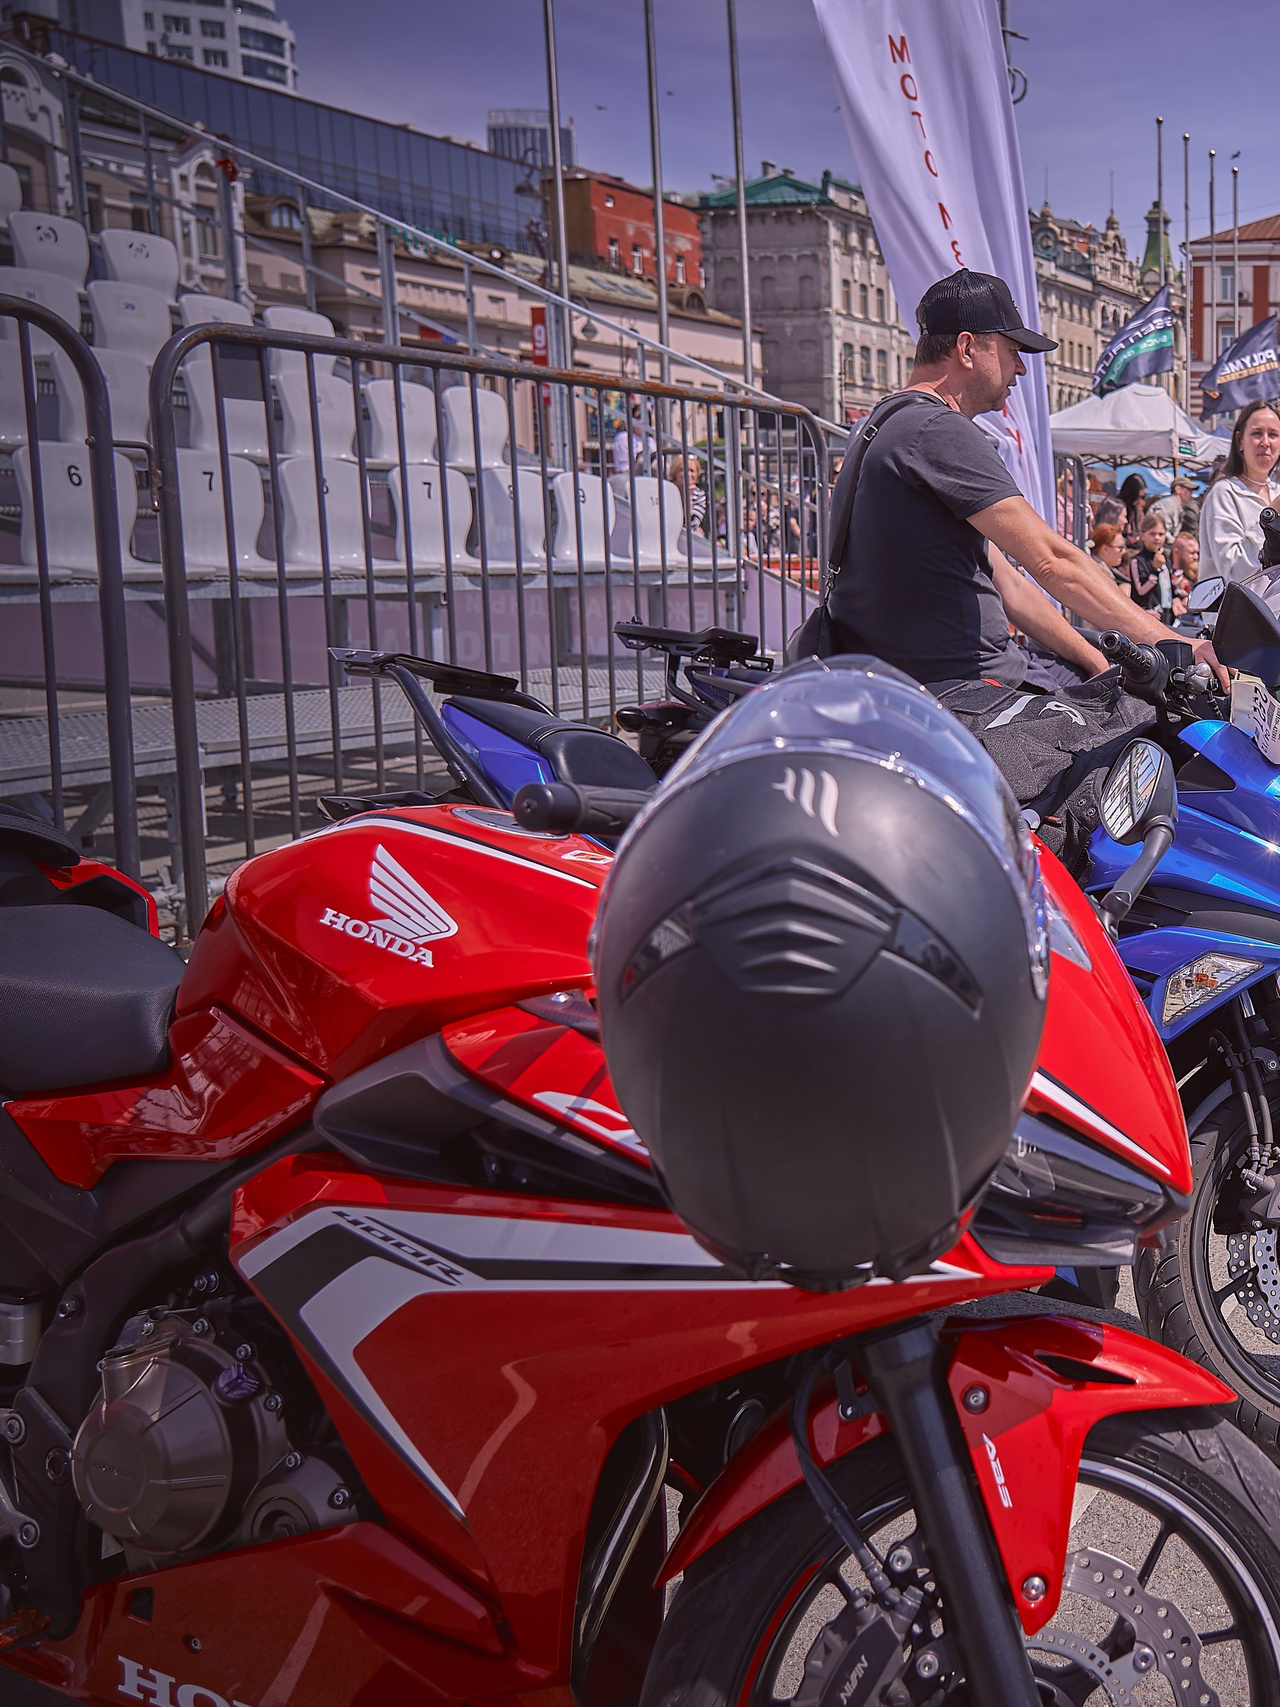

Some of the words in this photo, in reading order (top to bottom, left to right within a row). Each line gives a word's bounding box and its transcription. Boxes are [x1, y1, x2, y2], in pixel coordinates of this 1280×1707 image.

[887, 33, 939, 178] MOTO
[67, 465, 82, 487] 6
[202, 471, 214, 492] 7
[422, 481, 432, 500] 7
[319, 906, 435, 969] HONDA
[982, 1432, 1014, 1509] ABS
[117, 1654, 254, 1707] HO
